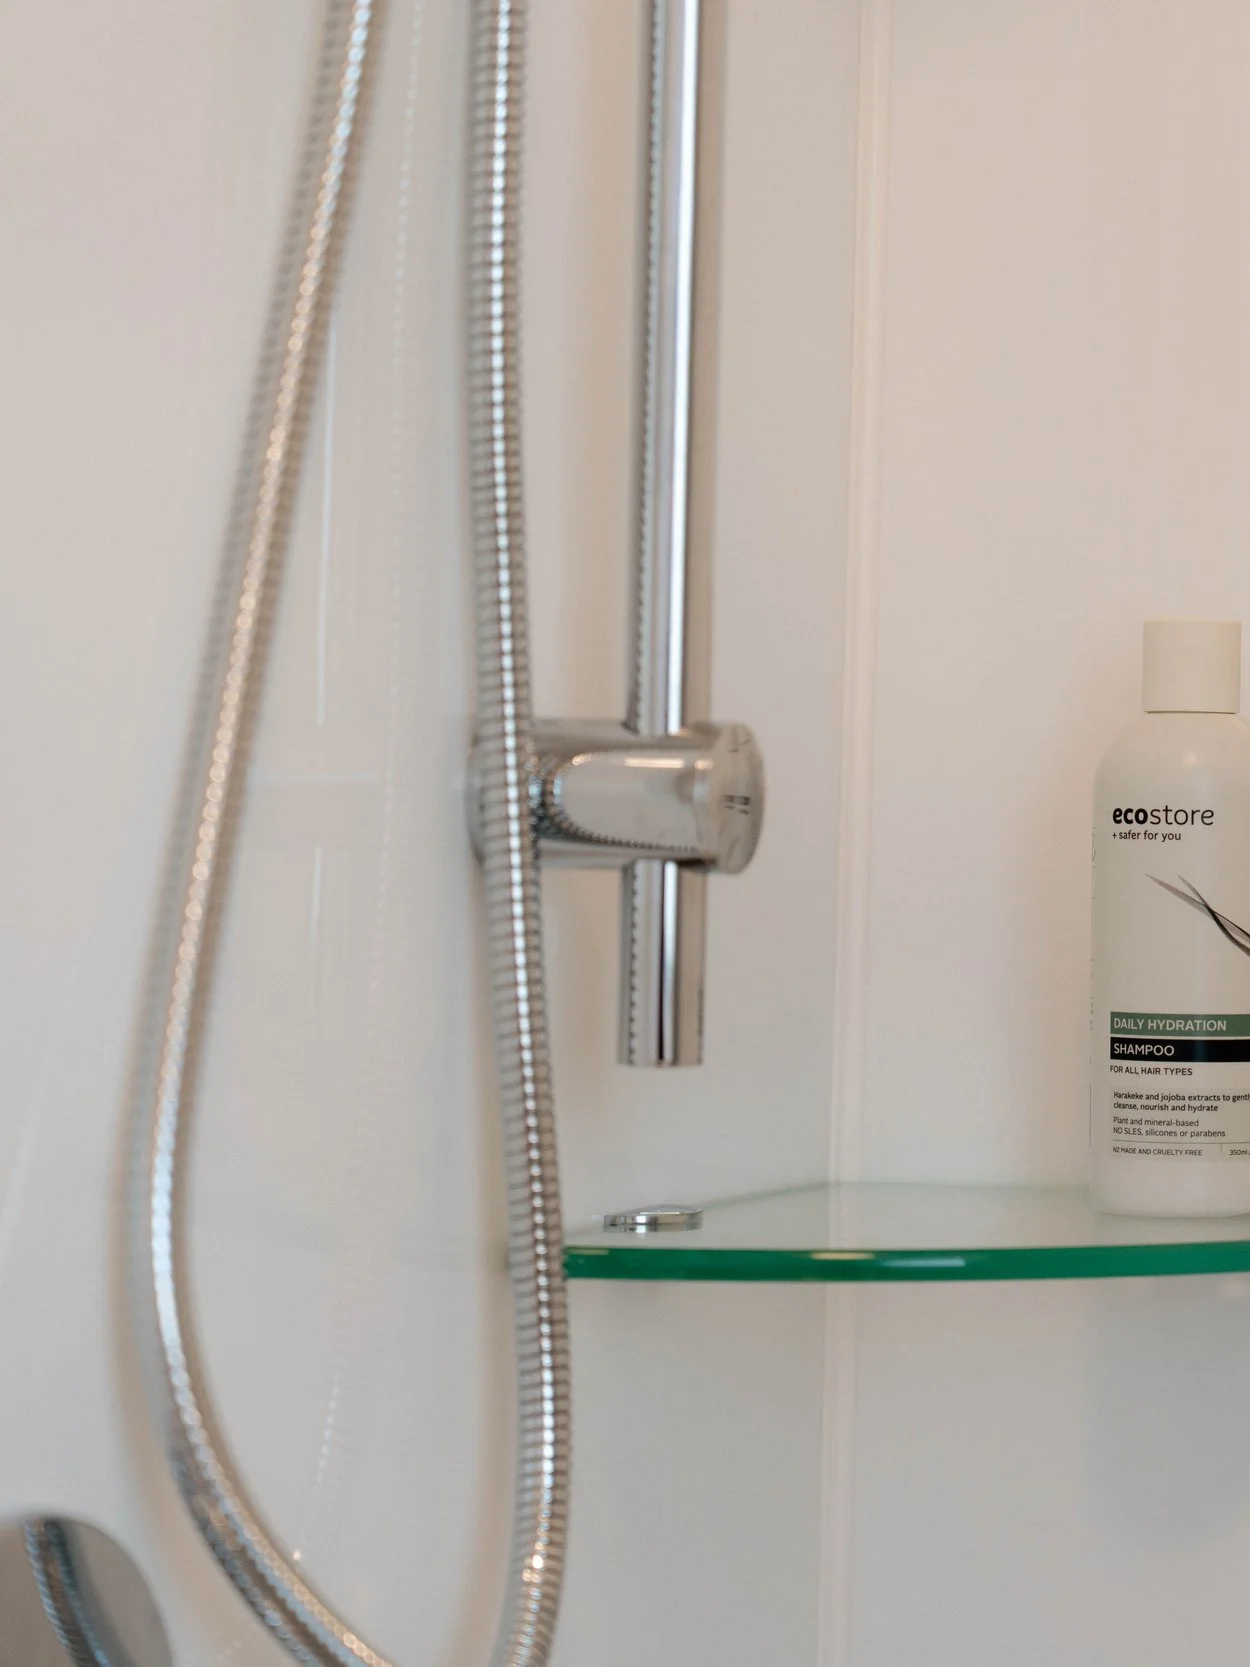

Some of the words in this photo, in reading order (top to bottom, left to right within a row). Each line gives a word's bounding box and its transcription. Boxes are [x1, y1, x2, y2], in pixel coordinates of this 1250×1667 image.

[1113, 805, 1214, 826] ecostore
[1119, 830, 1140, 840] safer
[1144, 830, 1158, 840] for
[1162, 832, 1181, 842] you
[1114, 1018, 1144, 1029] DAILY
[1148, 1019, 1226, 1031] HYDRATION
[1114, 1043, 1175, 1056] SHAMPOO
[1110, 1065, 1123, 1074] FOR
[1125, 1066, 1139, 1075] ALL
[1141, 1067, 1160, 1075] HAIR
[1164, 1068, 1193, 1076] TYPES
[1113, 1091, 1143, 1100] Harakeke
[1145, 1093, 1159, 1101] and
[1161, 1093, 1185, 1102] jojoba
[1113, 1102, 1139, 1111] cleanse,
[1140, 1103, 1169, 1111] nourish
[1187, 1104, 1218, 1113] hydrate
[1113, 1117, 1128, 1125] Plant
[1144, 1118, 1199, 1127] mineral-based
[1125, 1128, 1143, 1136] SLES,
[1145, 1129, 1177, 1137] silicones
[1190, 1129, 1226, 1138] parabens
